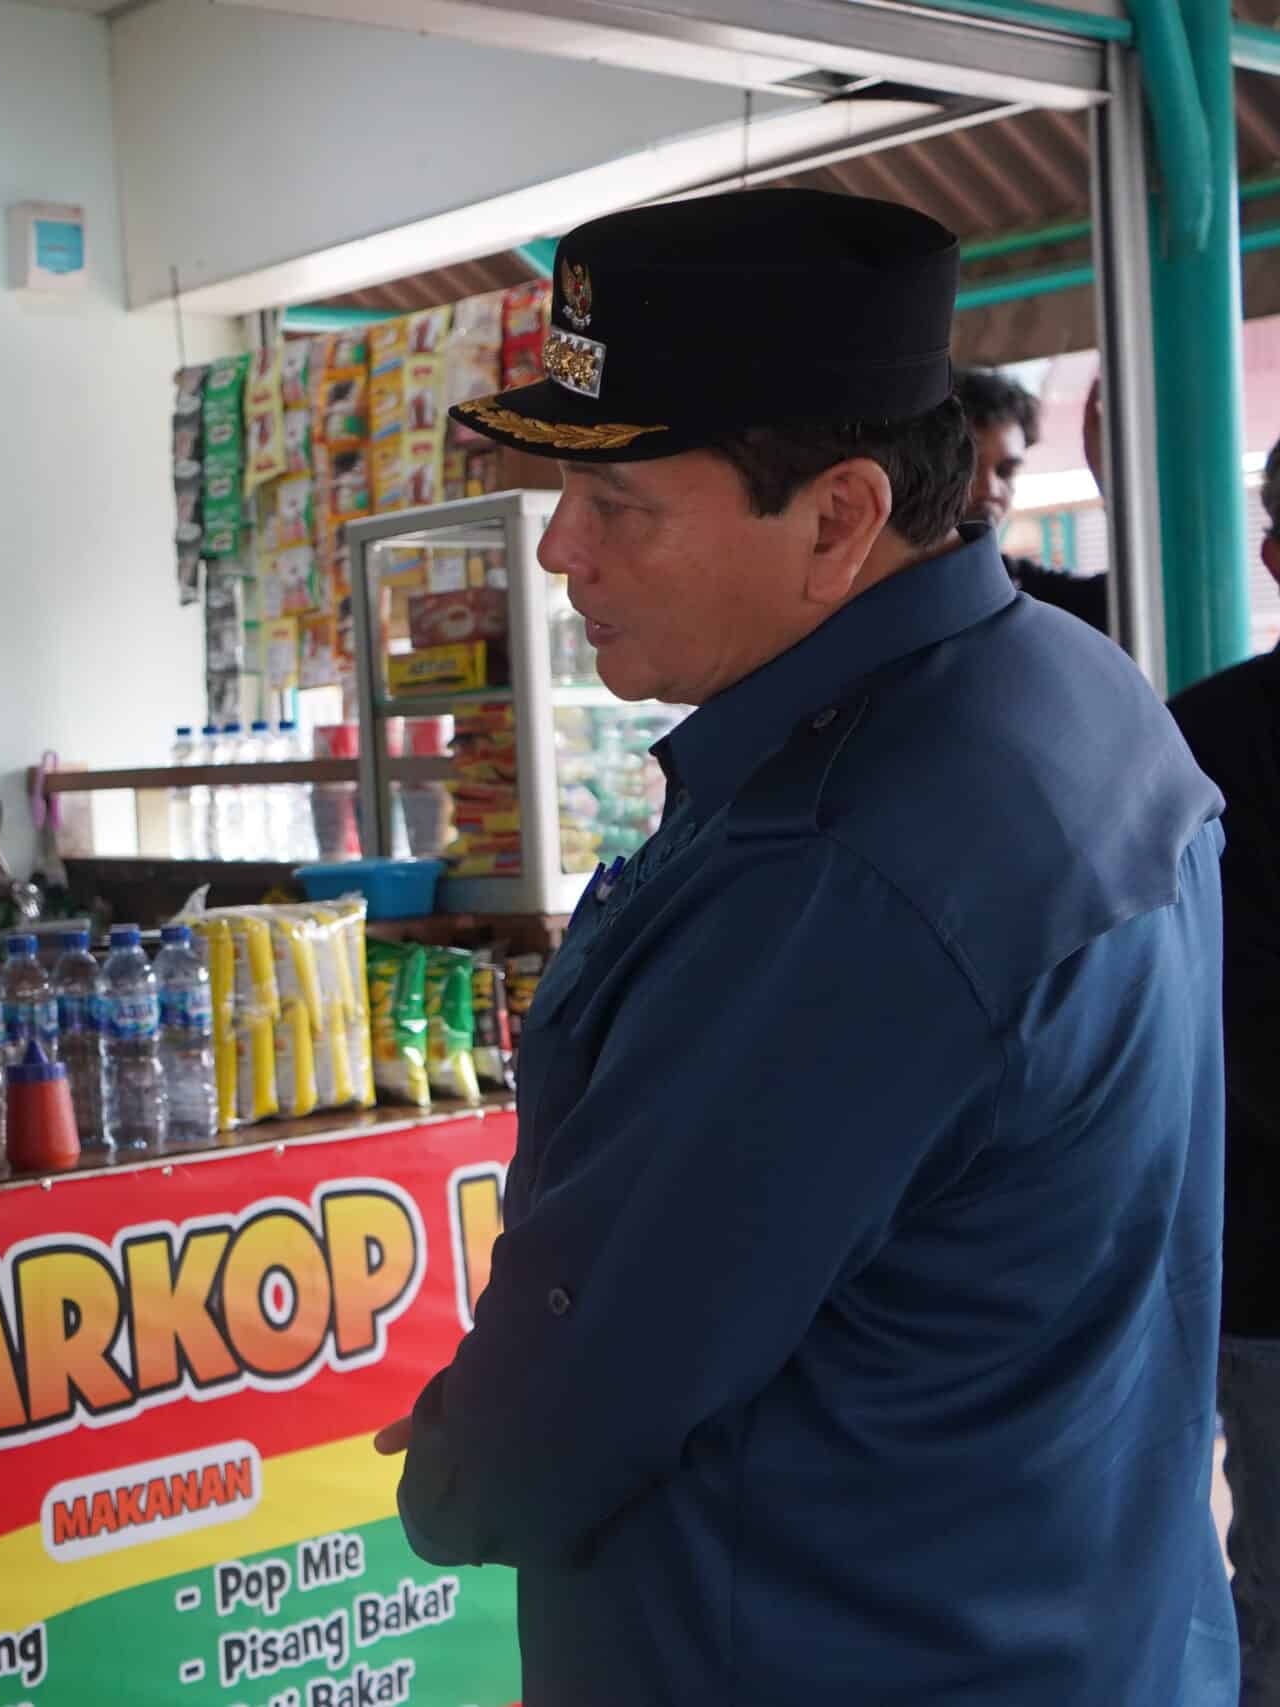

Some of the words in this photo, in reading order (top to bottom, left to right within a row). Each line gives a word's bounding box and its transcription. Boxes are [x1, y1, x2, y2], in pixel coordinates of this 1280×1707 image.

[52, 1456, 253, 1546] MAKANAN
[219, 1565, 286, 1609] Pop
[301, 1538, 361, 1585] Mie
[223, 1615, 344, 1682] Pisang
[358, 1584, 454, 1640] Bakar
[311, 1664, 410, 1707] Bakar
